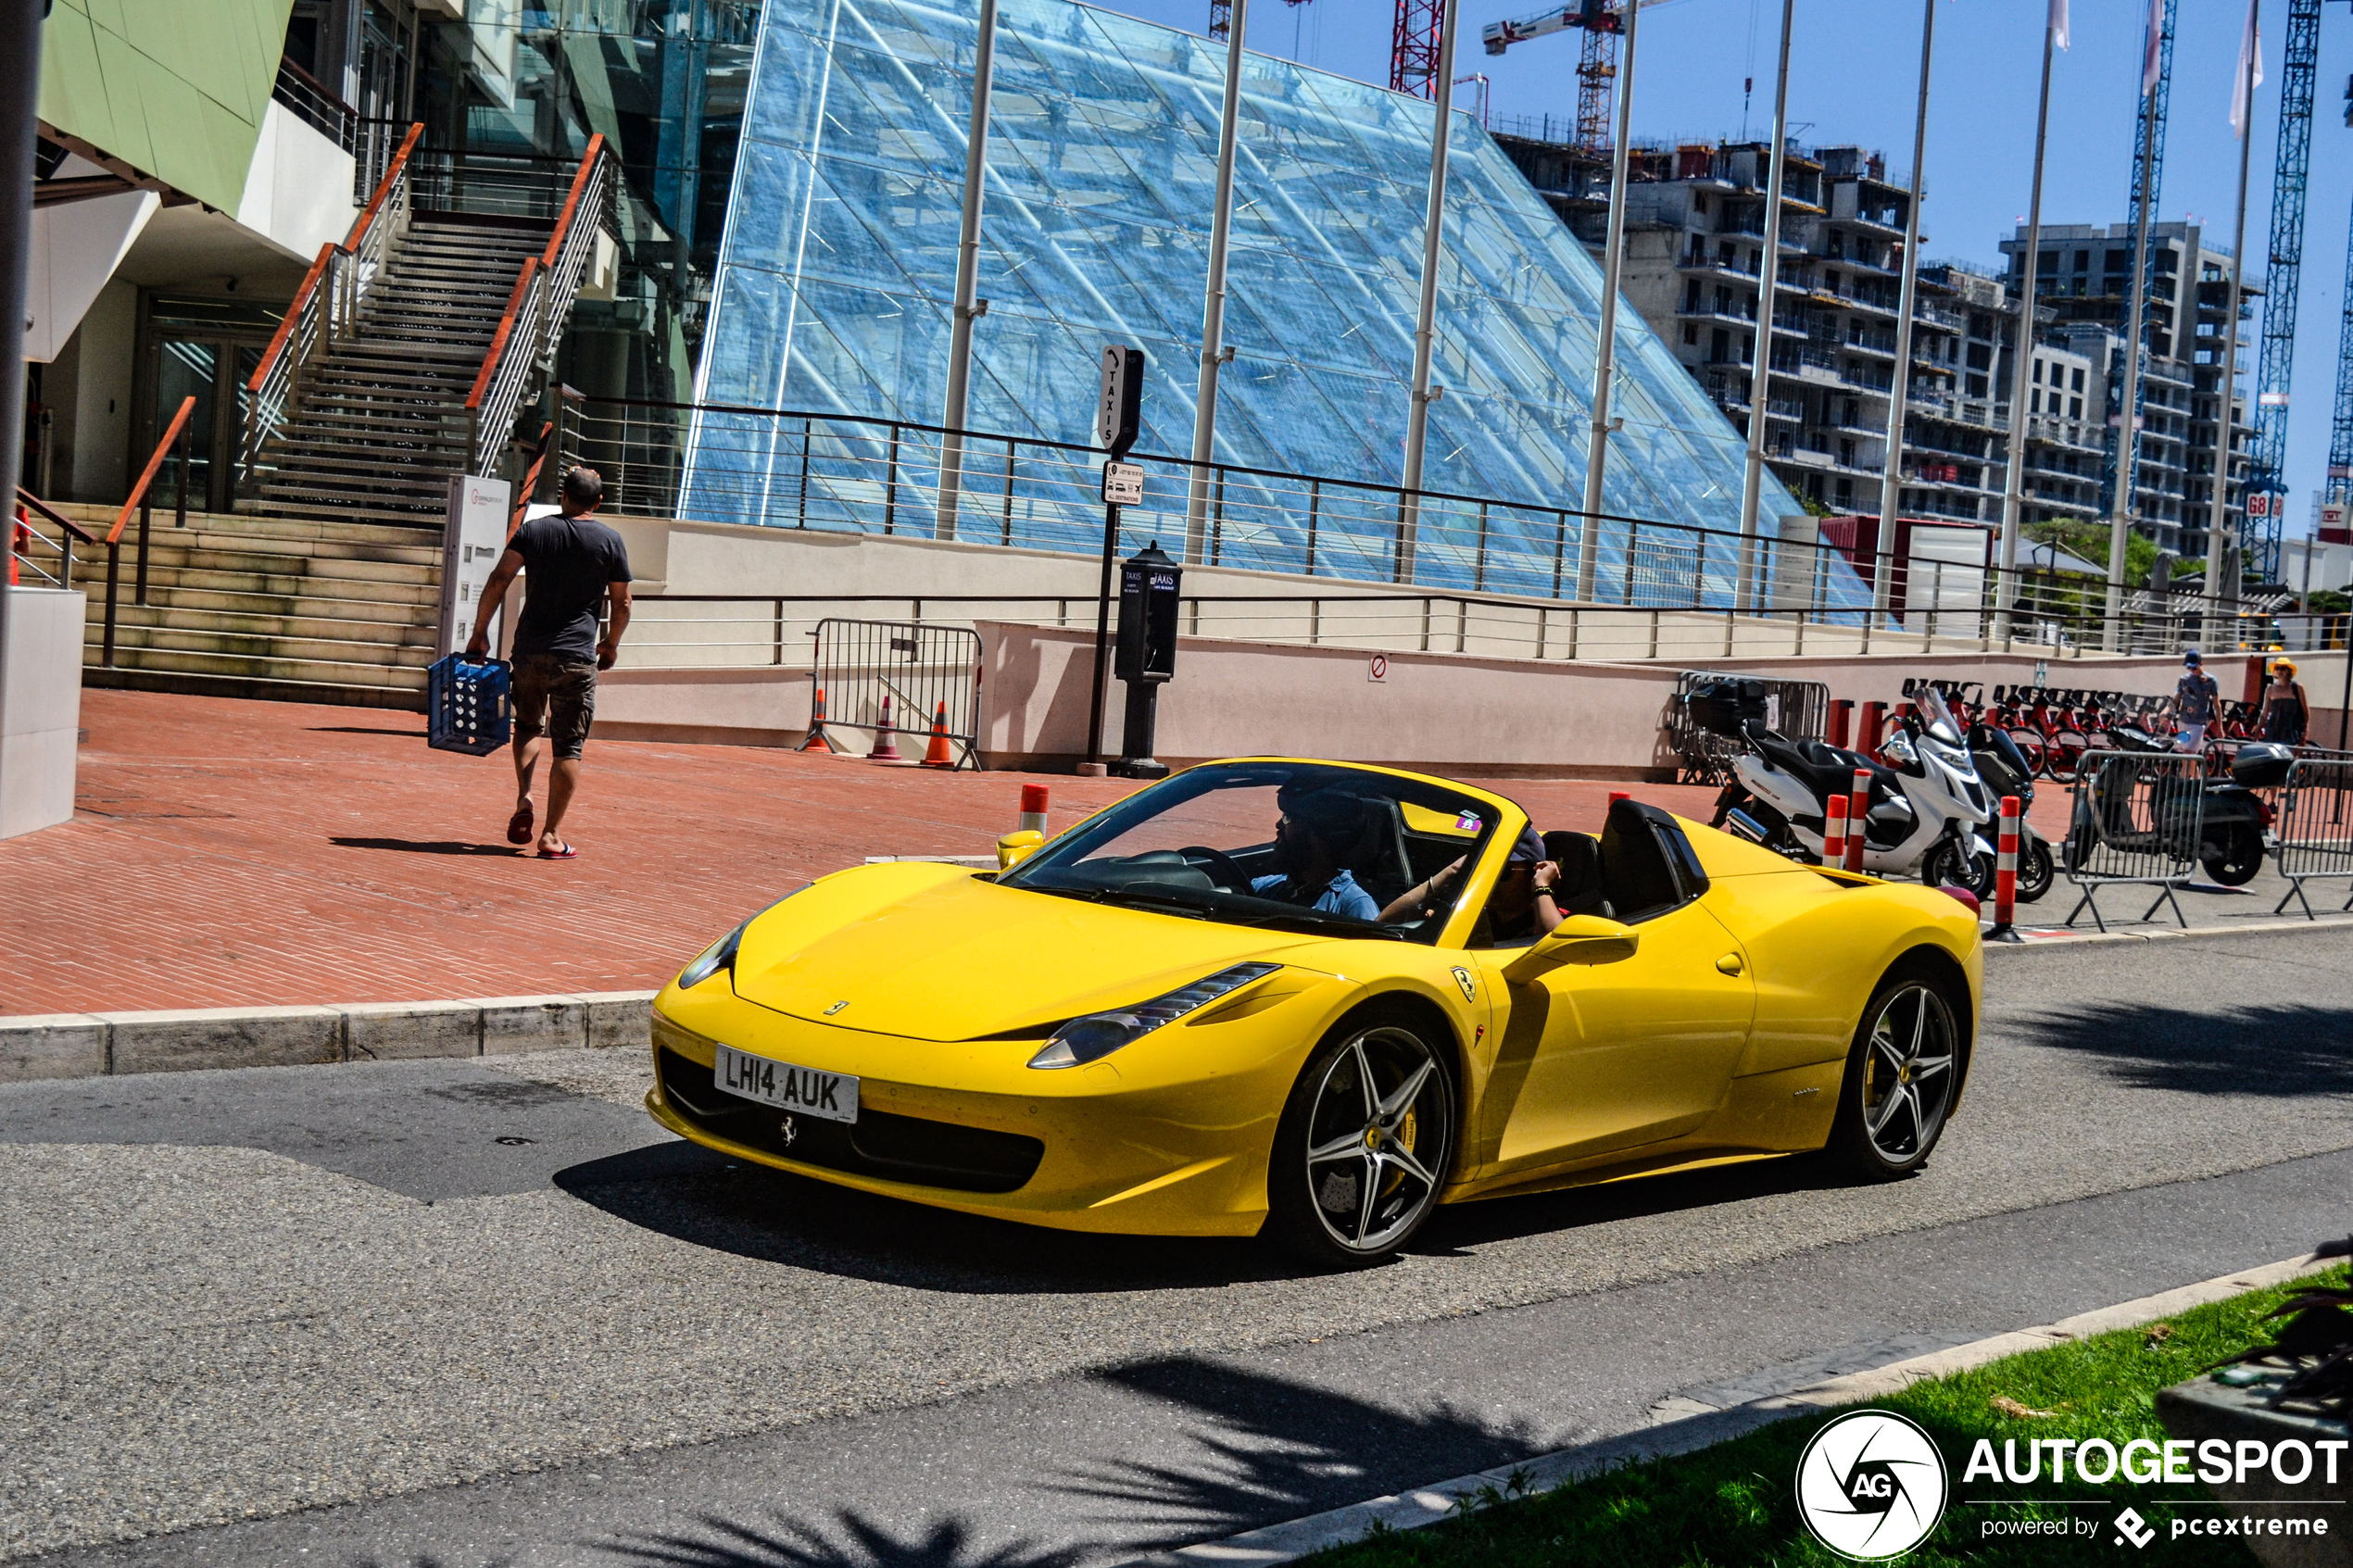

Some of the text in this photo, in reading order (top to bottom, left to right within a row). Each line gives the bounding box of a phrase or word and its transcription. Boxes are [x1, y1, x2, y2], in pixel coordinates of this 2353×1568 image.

[1105, 370, 1116, 440] TAXIS
[2249, 495, 2267, 515] G8
[1126, 572, 1141, 581] TAXIS
[1153, 572, 1174, 584] TAXIS
[726, 1052, 840, 1111] LH14 AUK
